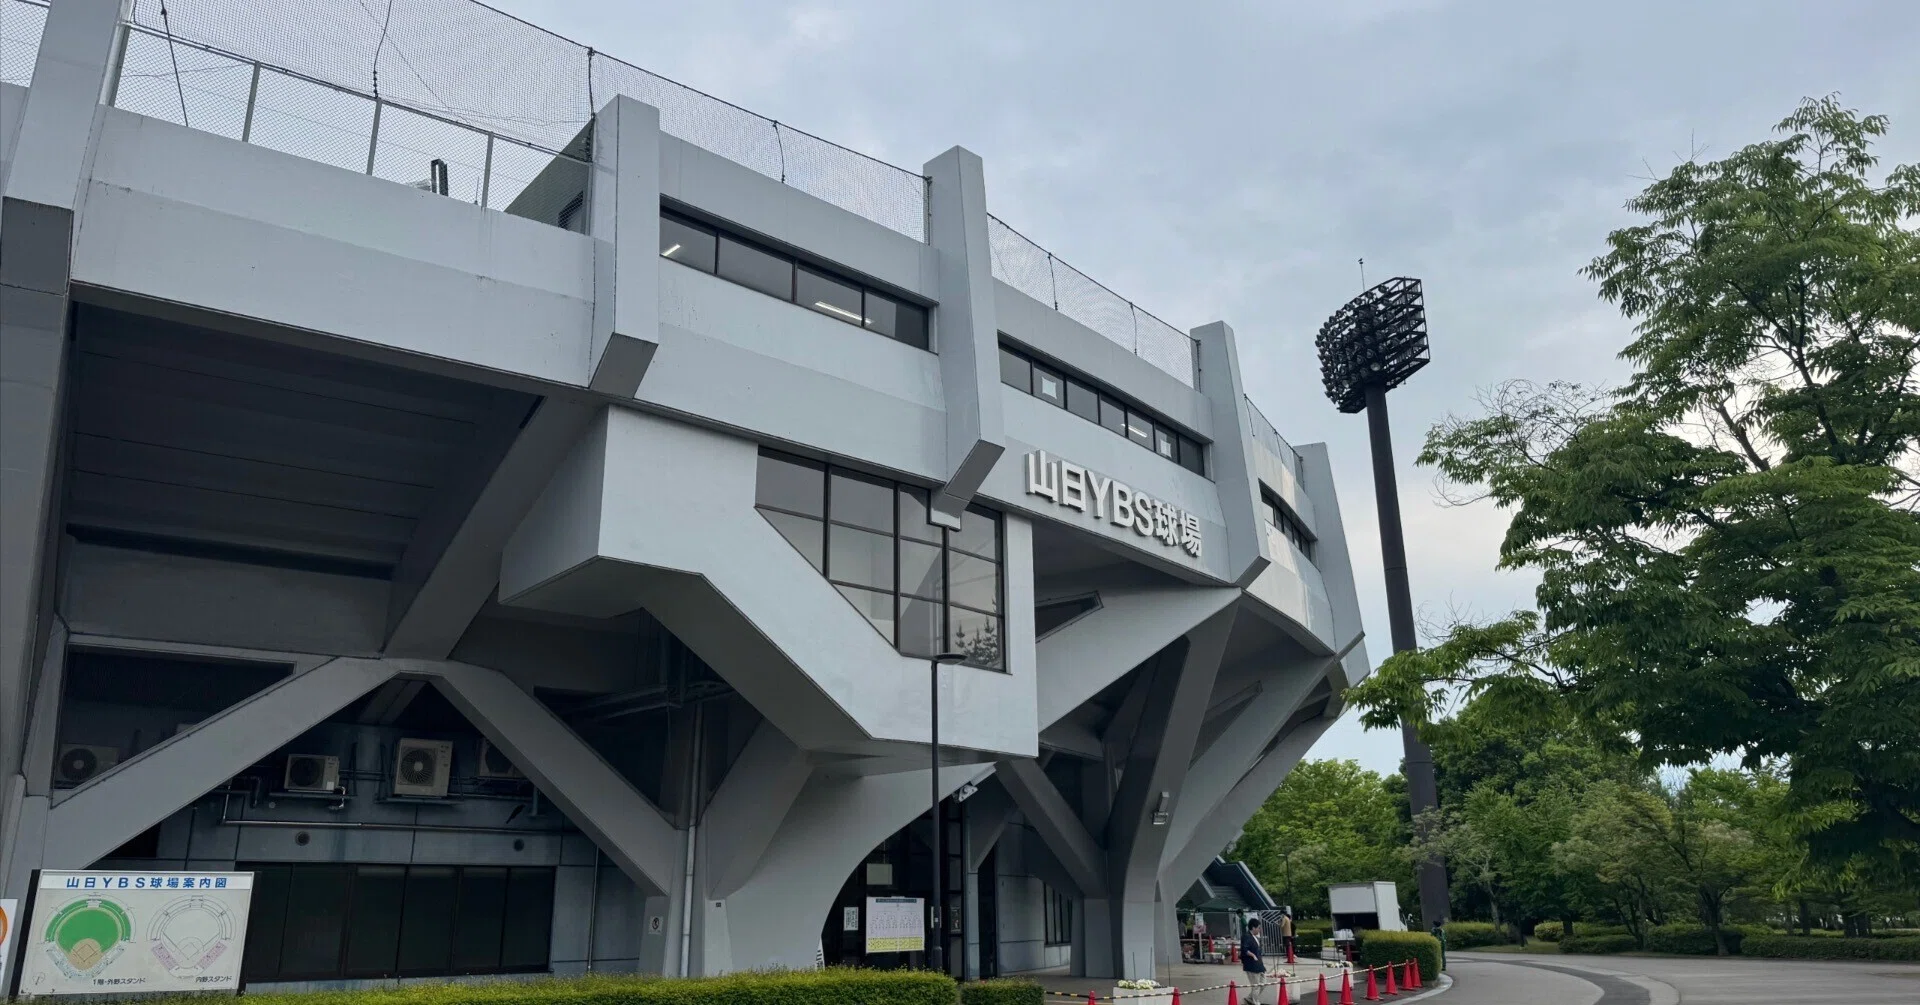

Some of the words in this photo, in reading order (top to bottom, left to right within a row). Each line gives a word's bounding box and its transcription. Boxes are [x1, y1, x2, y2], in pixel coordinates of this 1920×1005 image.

[1025, 450, 1202, 557] 山日YBS球場
[66, 877, 228, 889] 山日YBS球場案内図
